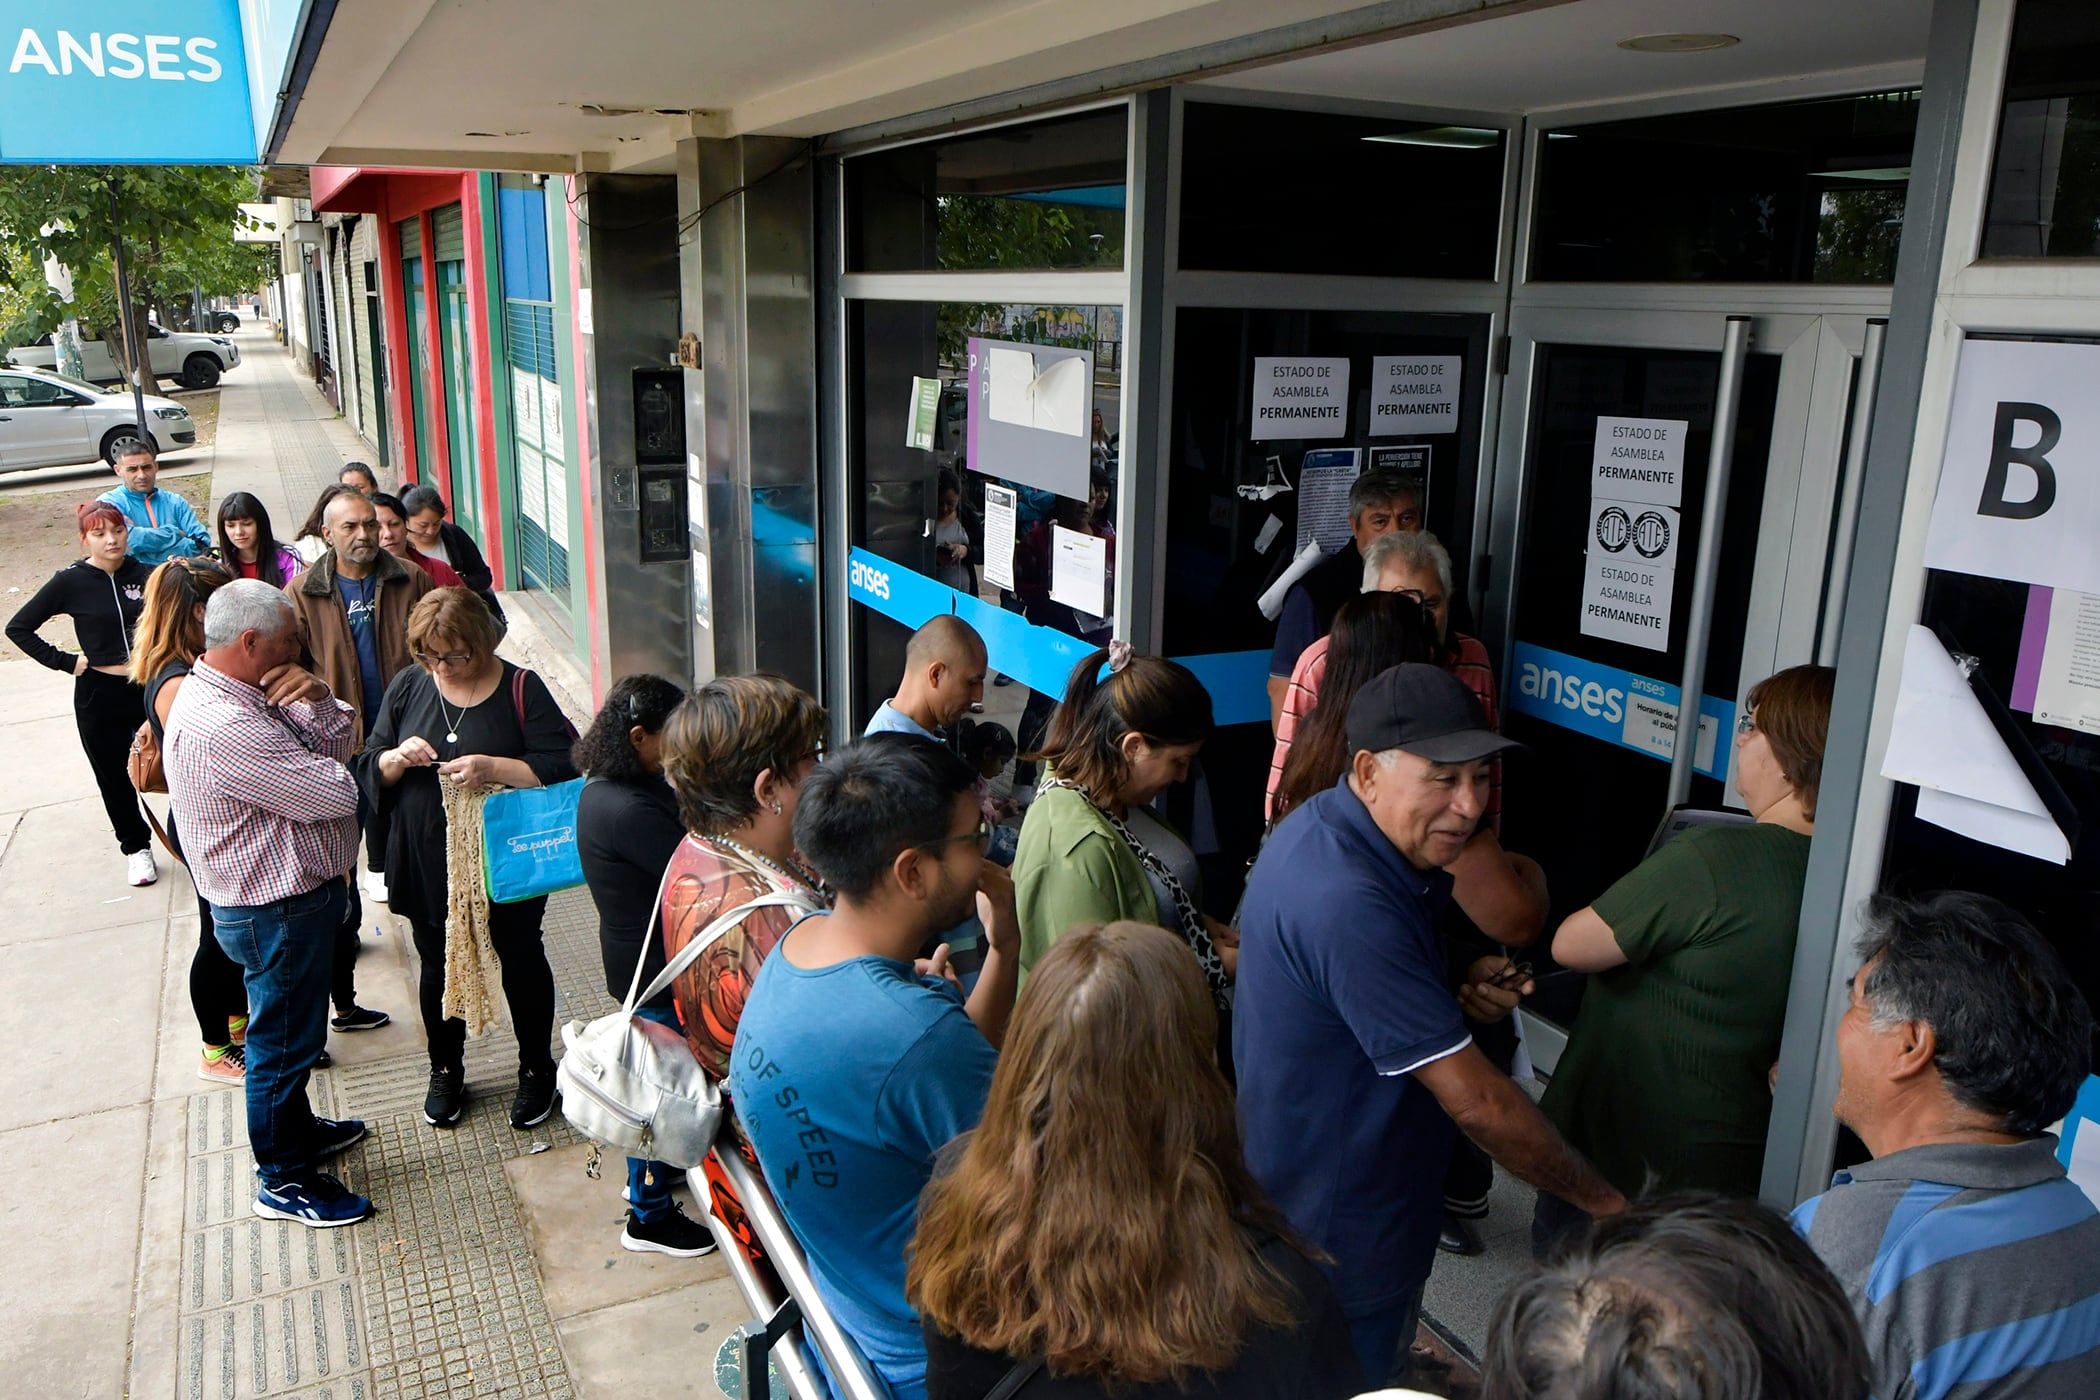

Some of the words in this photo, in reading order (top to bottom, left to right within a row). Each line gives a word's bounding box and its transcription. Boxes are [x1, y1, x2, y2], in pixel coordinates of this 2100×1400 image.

[8, 27, 223, 83] ANSES
[1273, 366, 1315, 378] ESTADO
[1317, 366, 1331, 378] DE
[1390, 364, 1429, 376] ESTADO
[1431, 364, 1444, 375] DE
[1272, 386, 1329, 398] ASAMBLEA
[1390, 383, 1442, 395] ASAMBLEA
[1260, 406, 1340, 419] PERMANENTE
[1377, 402, 1452, 415] PERMANENTE
[1612, 426, 1652, 440] ESTADO
[1654, 428, 1668, 440] DE
[1610, 446, 1665, 461] ASAMBLEA
[1977, 401, 2062, 520] B
[1598, 465, 1675, 484] PERMANENTE
[851, 559, 890, 601] anses
[1601, 567, 1639, 584] ESTADO
[1641, 573, 1655, 587] DE
[1600, 586, 1652, 606] ASAMBLEA
[1588, 603, 1662, 630] PERMANENTE
[1519, 662, 1624, 724] anses
[1631, 678, 1666, 697] anses
[1636, 703, 1663, 717] Horario
[1663, 711, 1674, 720] de
[748, 1046, 782, 1081] OF
[775, 1086, 838, 1189] SPEED
